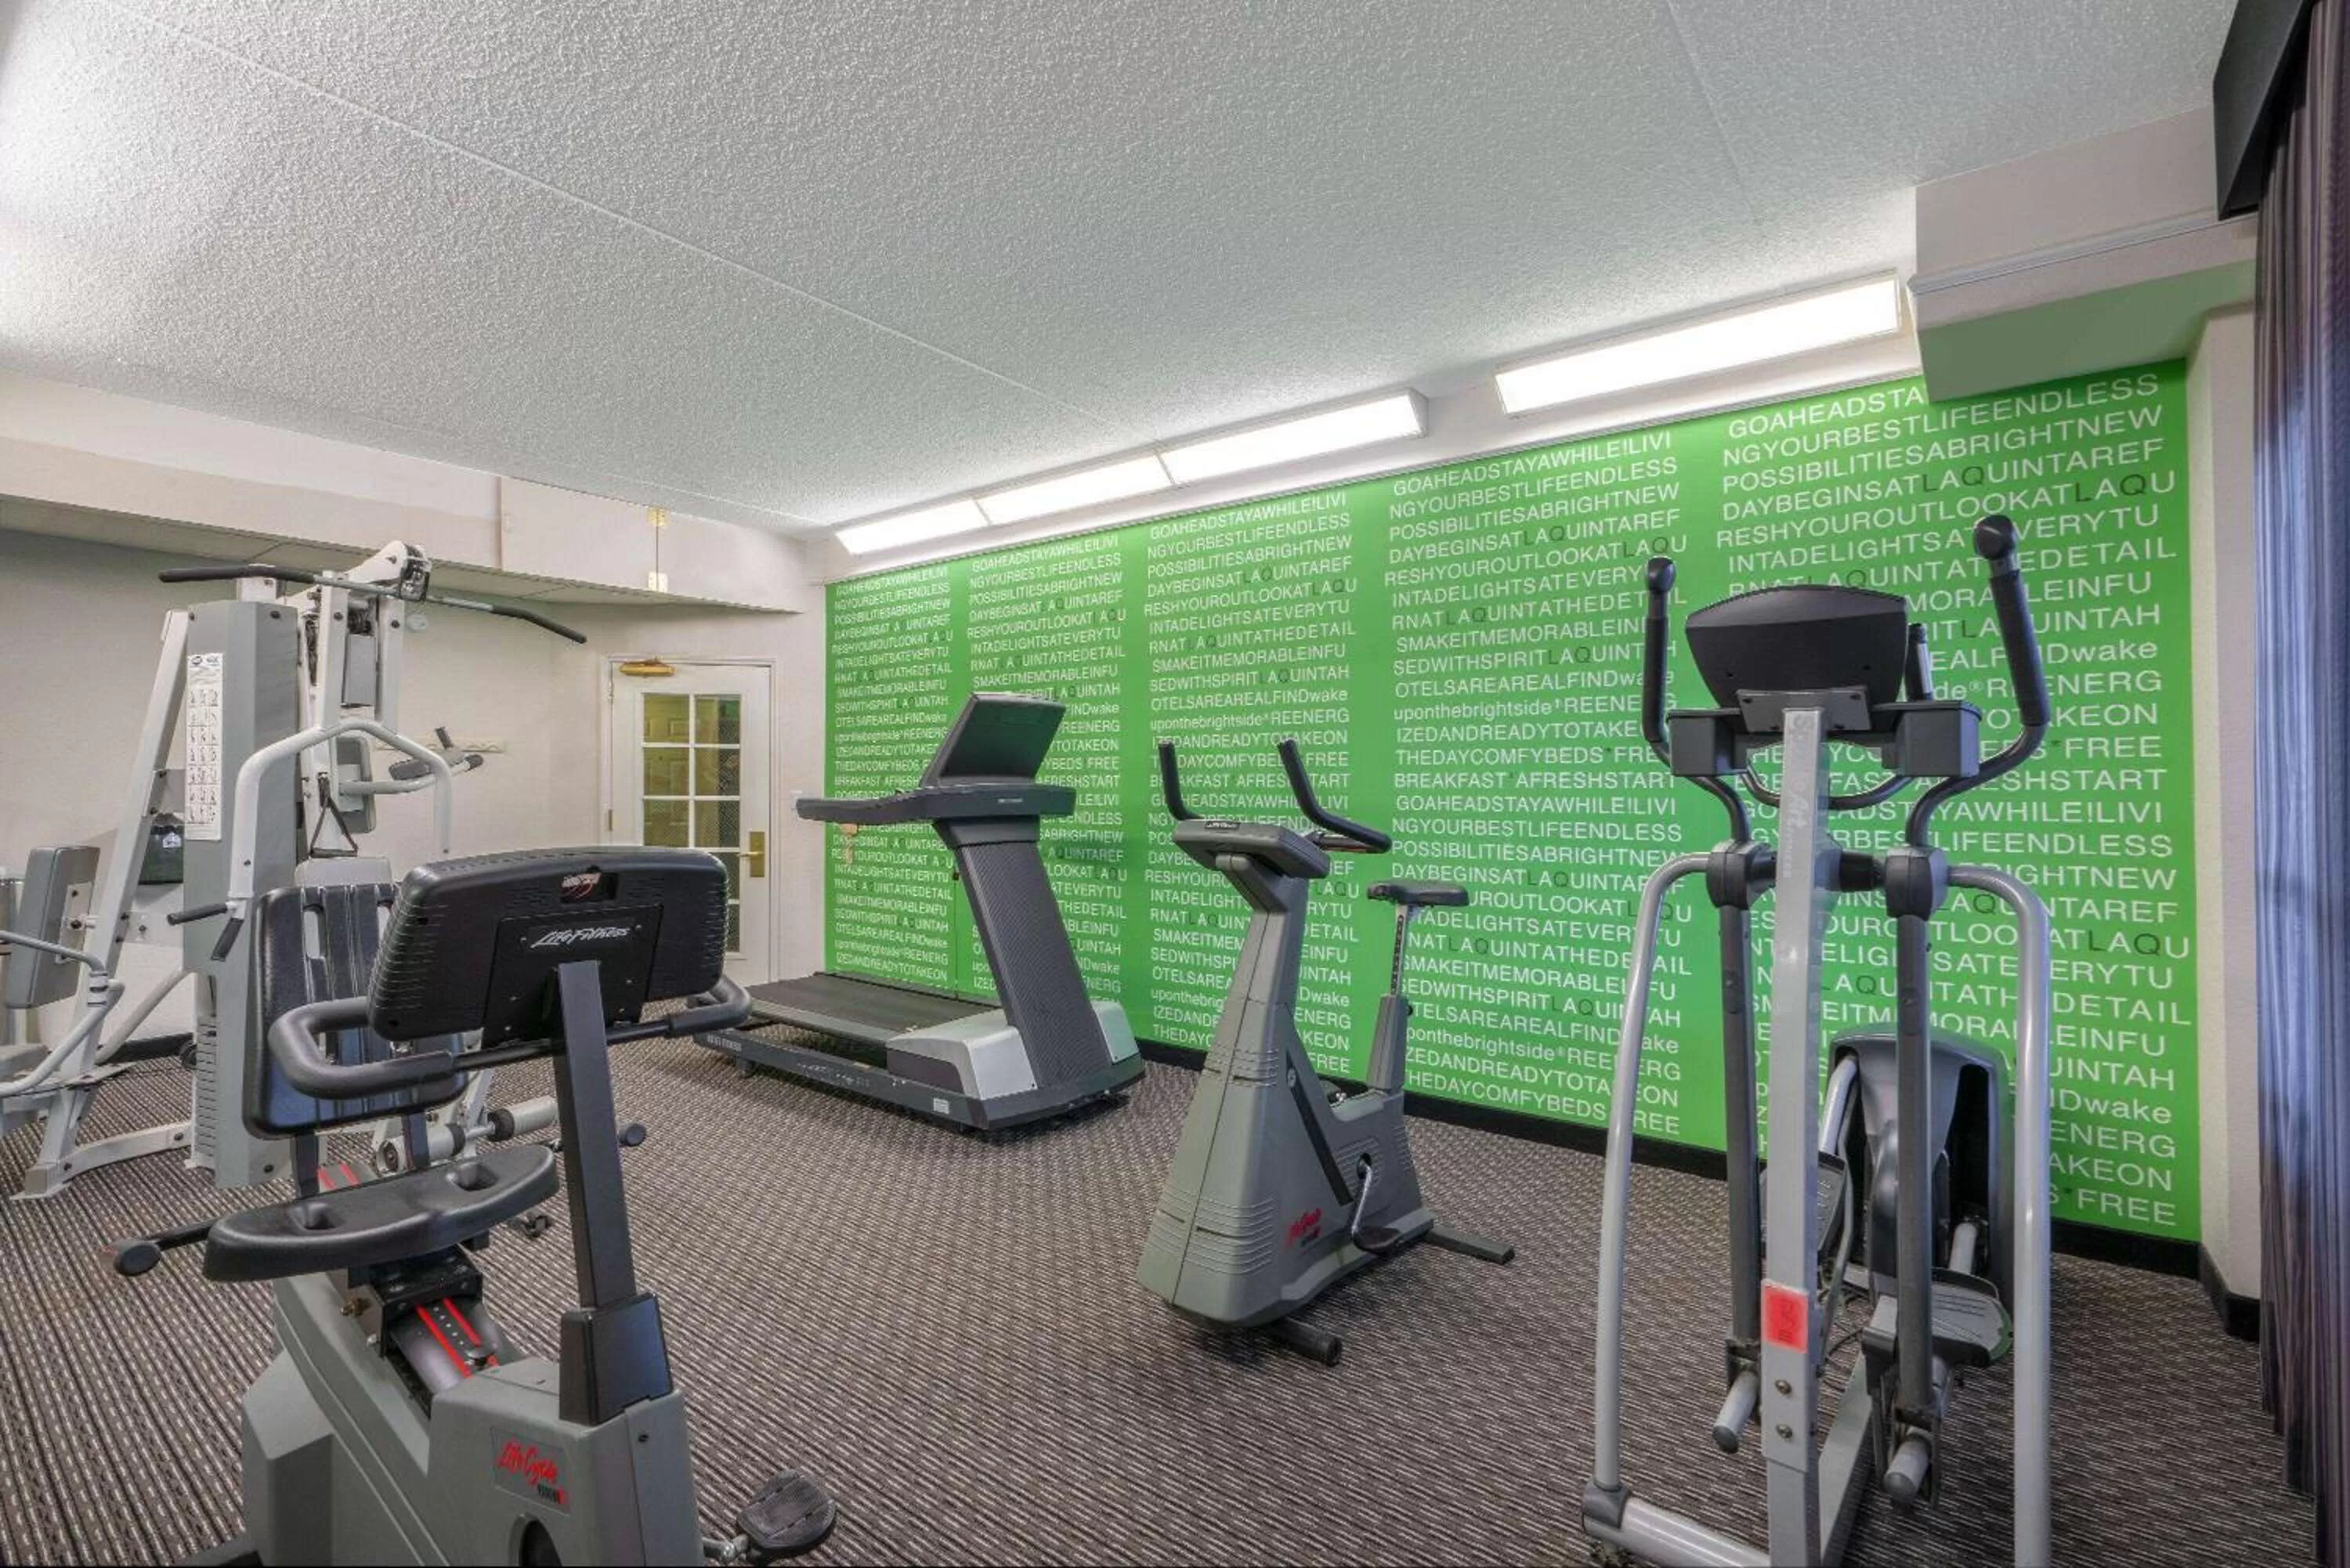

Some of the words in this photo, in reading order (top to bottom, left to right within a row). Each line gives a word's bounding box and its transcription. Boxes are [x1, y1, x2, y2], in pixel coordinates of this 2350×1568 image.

[1723, 374, 2159, 468] NGYOURBESTLIFEENDLESS
[1729, 385, 1925, 439] GOAHEADSTA
[1394, 432, 1671, 497] GOAHEADSTAYAWHILE!LIVI
[1723, 405, 2162, 494] POSSIBILITIESABRIGHTNEW
[1390, 457, 1678, 519] NGYOURBESTLIFEENDLESS
[1723, 438, 2164, 521] DAYBEGINSATLAQUINTAREF
[1390, 482, 1679, 541] POSSIBILITIESABRIGHTNEW
[1716, 470, 2175, 548] RESHYOUROUTLOOKATLAQU
[1729, 504, 2159, 574] INTADELIGHTSAVERYTU
[1392, 587, 1687, 630] RNATLAQUINTATHEDETIL
[1393, 565, 1642, 608] INTADELIGHTSATEVERY
[1397, 615, 1670, 652] SMAKEITMEMORABLEIN
[1393, 641, 1677, 676] SEDWITHSPIRITLAQUINTH
[1395, 670, 1675, 699] OTELSAREAREALFINDwae
[1397, 720, 1643, 743] IZEDANDREADYTOTAKE
[2065, 735, 2162, 760] FREE
[1614, 746, 1661, 764] FRE
[1150, 773, 1230, 788] BAKFAST
[1236, 773, 1350, 788] AFRESTART
[1392, 818, 1682, 843] NGYOURBESTLIFEENDLESS
[1391, 863, 1686, 895] DAYBEGINSATLAQUINTARF
[1408, 933, 1692, 976] NATLAQUINTATHEDEAIL
[1403, 956, 1676, 1001] SMAKEITMEMORABLEIU
[1401, 978, 1681, 1028] SEDWITHSPIRITLAQUIAH
[1413, 1003, 1679, 1054] TELSAREAREALFINDake
[1406, 1046, 1679, 1107] ZEDANDREADYTOTAON
[1405, 1070, 1606, 1120] HEDAYCOMFYBEDS
[1634, 1110, 1679, 1134] REE
[2077, 1188, 2177, 1227] FREE
